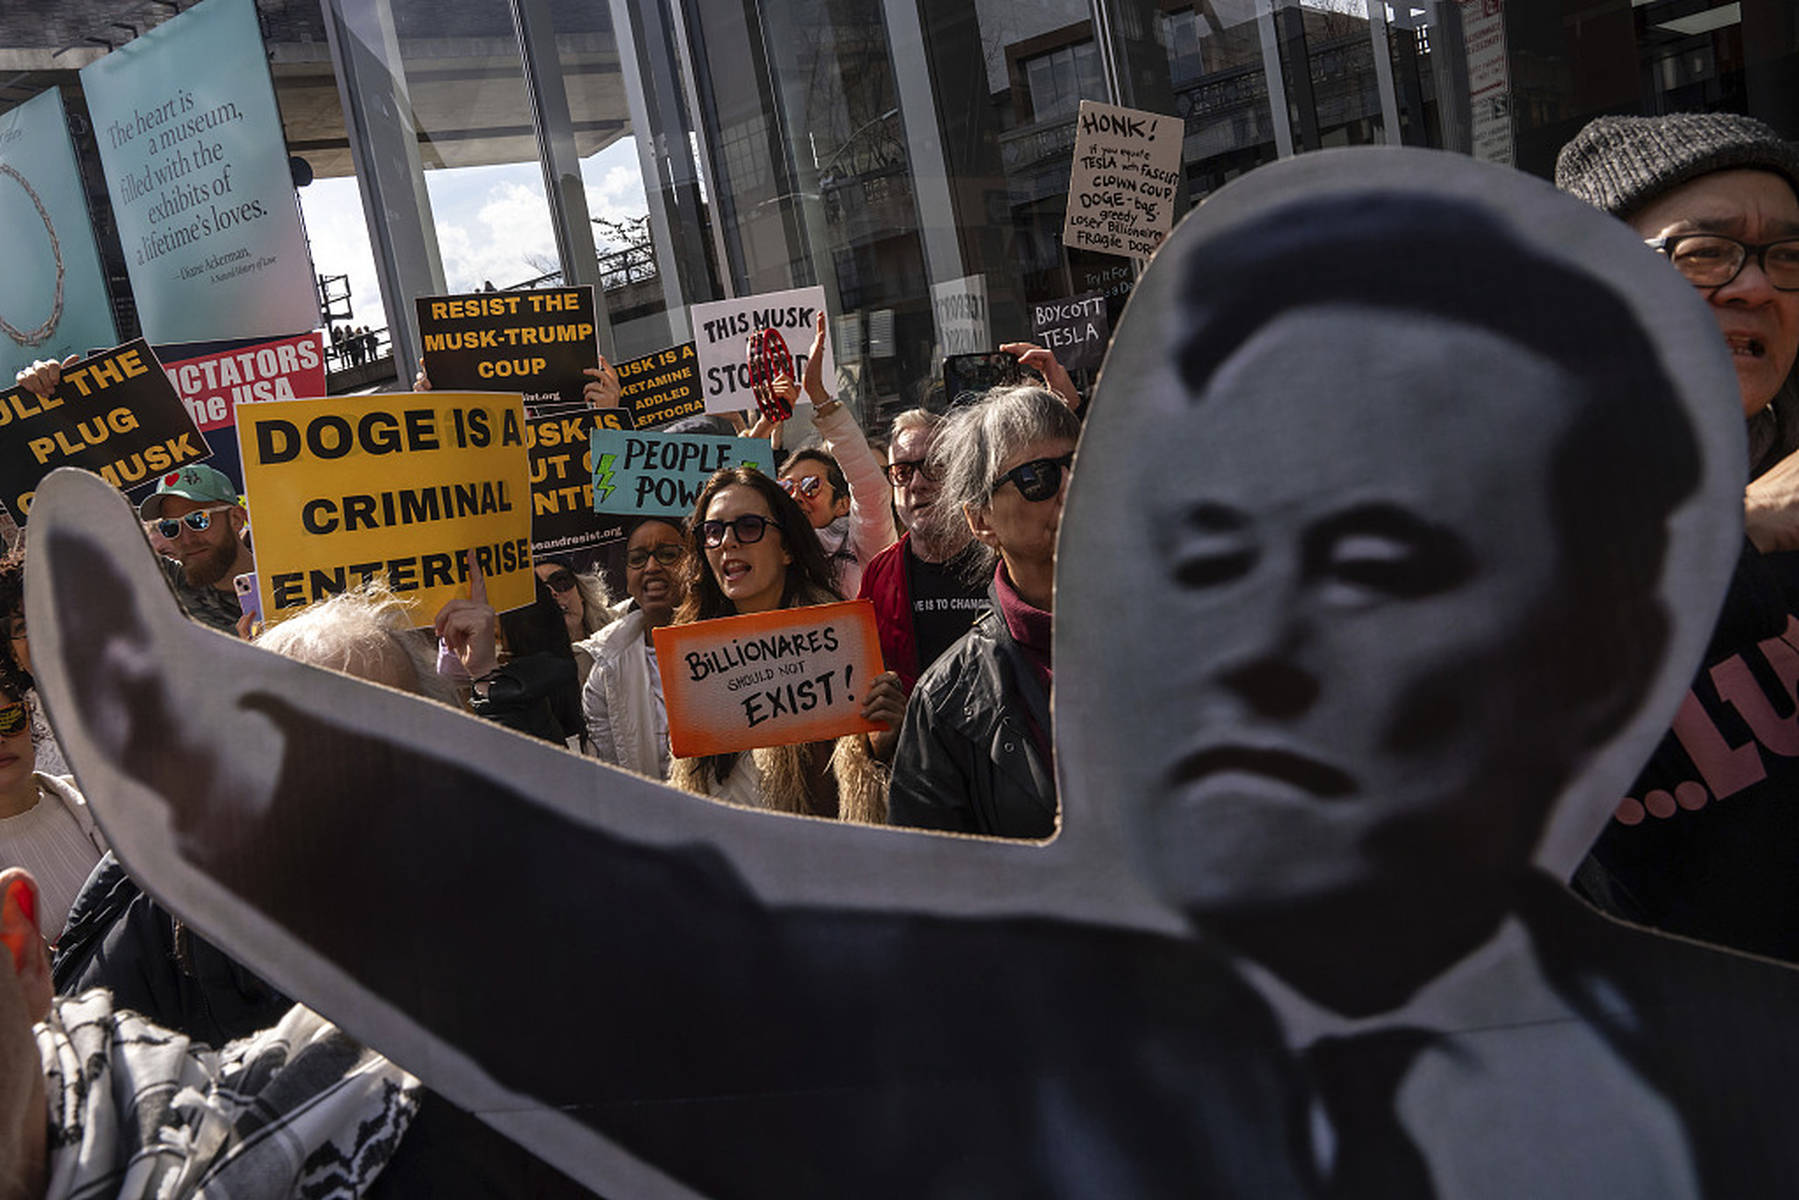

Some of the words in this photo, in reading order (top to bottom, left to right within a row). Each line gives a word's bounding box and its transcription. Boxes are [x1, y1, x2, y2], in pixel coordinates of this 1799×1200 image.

[108, 120, 133, 149] The
[135, 101, 176, 135] heart
[179, 90, 194, 113] is
[149, 138, 158, 155] a
[161, 103, 243, 149] museum,
[1082, 113, 1158, 141] HONK!
[120, 165, 154, 205] filled
[155, 150, 191, 185] with
[194, 141, 223, 169] the
[1081, 156, 1117, 170] TESLA
[148, 184, 209, 224] exhibits
[213, 164, 233, 196] of
[1093, 175, 1137, 192] CLOWN
[137, 250, 145, 266] a
[143, 215, 211, 261] lifetime's
[211, 199, 268, 231] loves.
[1100, 210, 1138, 227] greedy
[431, 296, 521, 320] RESIST
[528, 293, 580, 314] THE
[1036, 297, 1104, 325] BOYCOTT
[424, 323, 593, 352] MUSK-TRUMP
[704, 312, 749, 344] THIS
[753, 307, 815, 331] MUSK
[1039, 323, 1099, 348] TESLA
[63, 349, 149, 397] THE
[166, 340, 319, 399] ICTATORS
[477, 358, 546, 379] COUP
[617, 357, 655, 377] USK
[658, 350, 677, 366] IS
[682, 345, 695, 359] A
[620, 366, 692, 397] KETAMINE
[184, 396, 227, 424] he
[636, 386, 690, 410] ADDLED
[27, 407, 140, 464] PLUG
[255, 408, 439, 465] DOGE
[453, 409, 493, 449] IS
[502, 408, 523, 448] A
[530, 454, 570, 483] UT
[624, 439, 732, 472] PEOPLE
[302, 481, 512, 535] CRIMINAL
[635, 476, 704, 508] POW
[936, 598, 948, 610] TO
[727, 667, 774, 692] SHOULD
[778, 660, 806, 677] NOT
